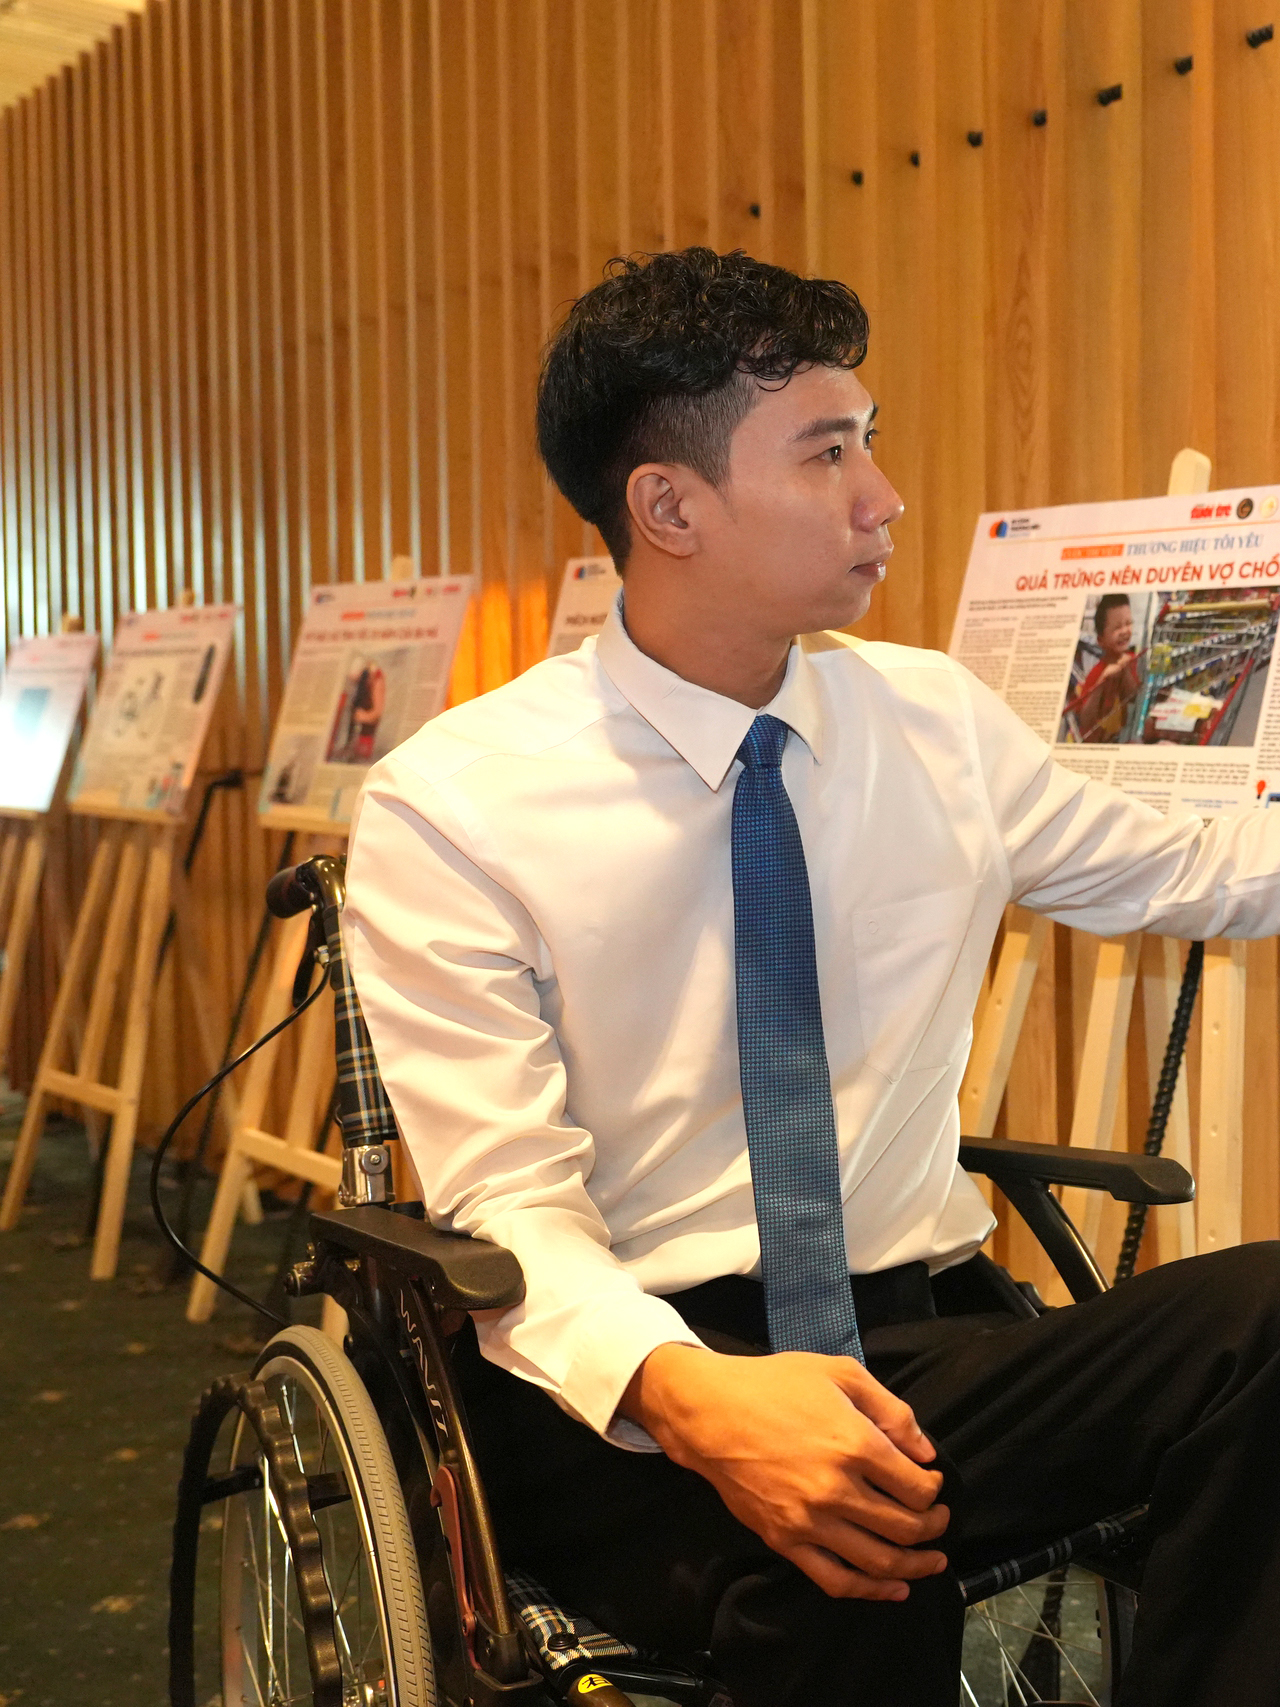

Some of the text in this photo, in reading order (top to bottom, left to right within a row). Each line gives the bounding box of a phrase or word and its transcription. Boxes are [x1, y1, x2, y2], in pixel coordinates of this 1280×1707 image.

[1016, 570, 1048, 591] QUẢ
[1054, 570, 1105, 588] TRỨNG
[1109, 565, 1142, 586] NÊN
[1146, 561, 1204, 584] DUYÊN
[1209, 562, 1235, 582] VỢ
